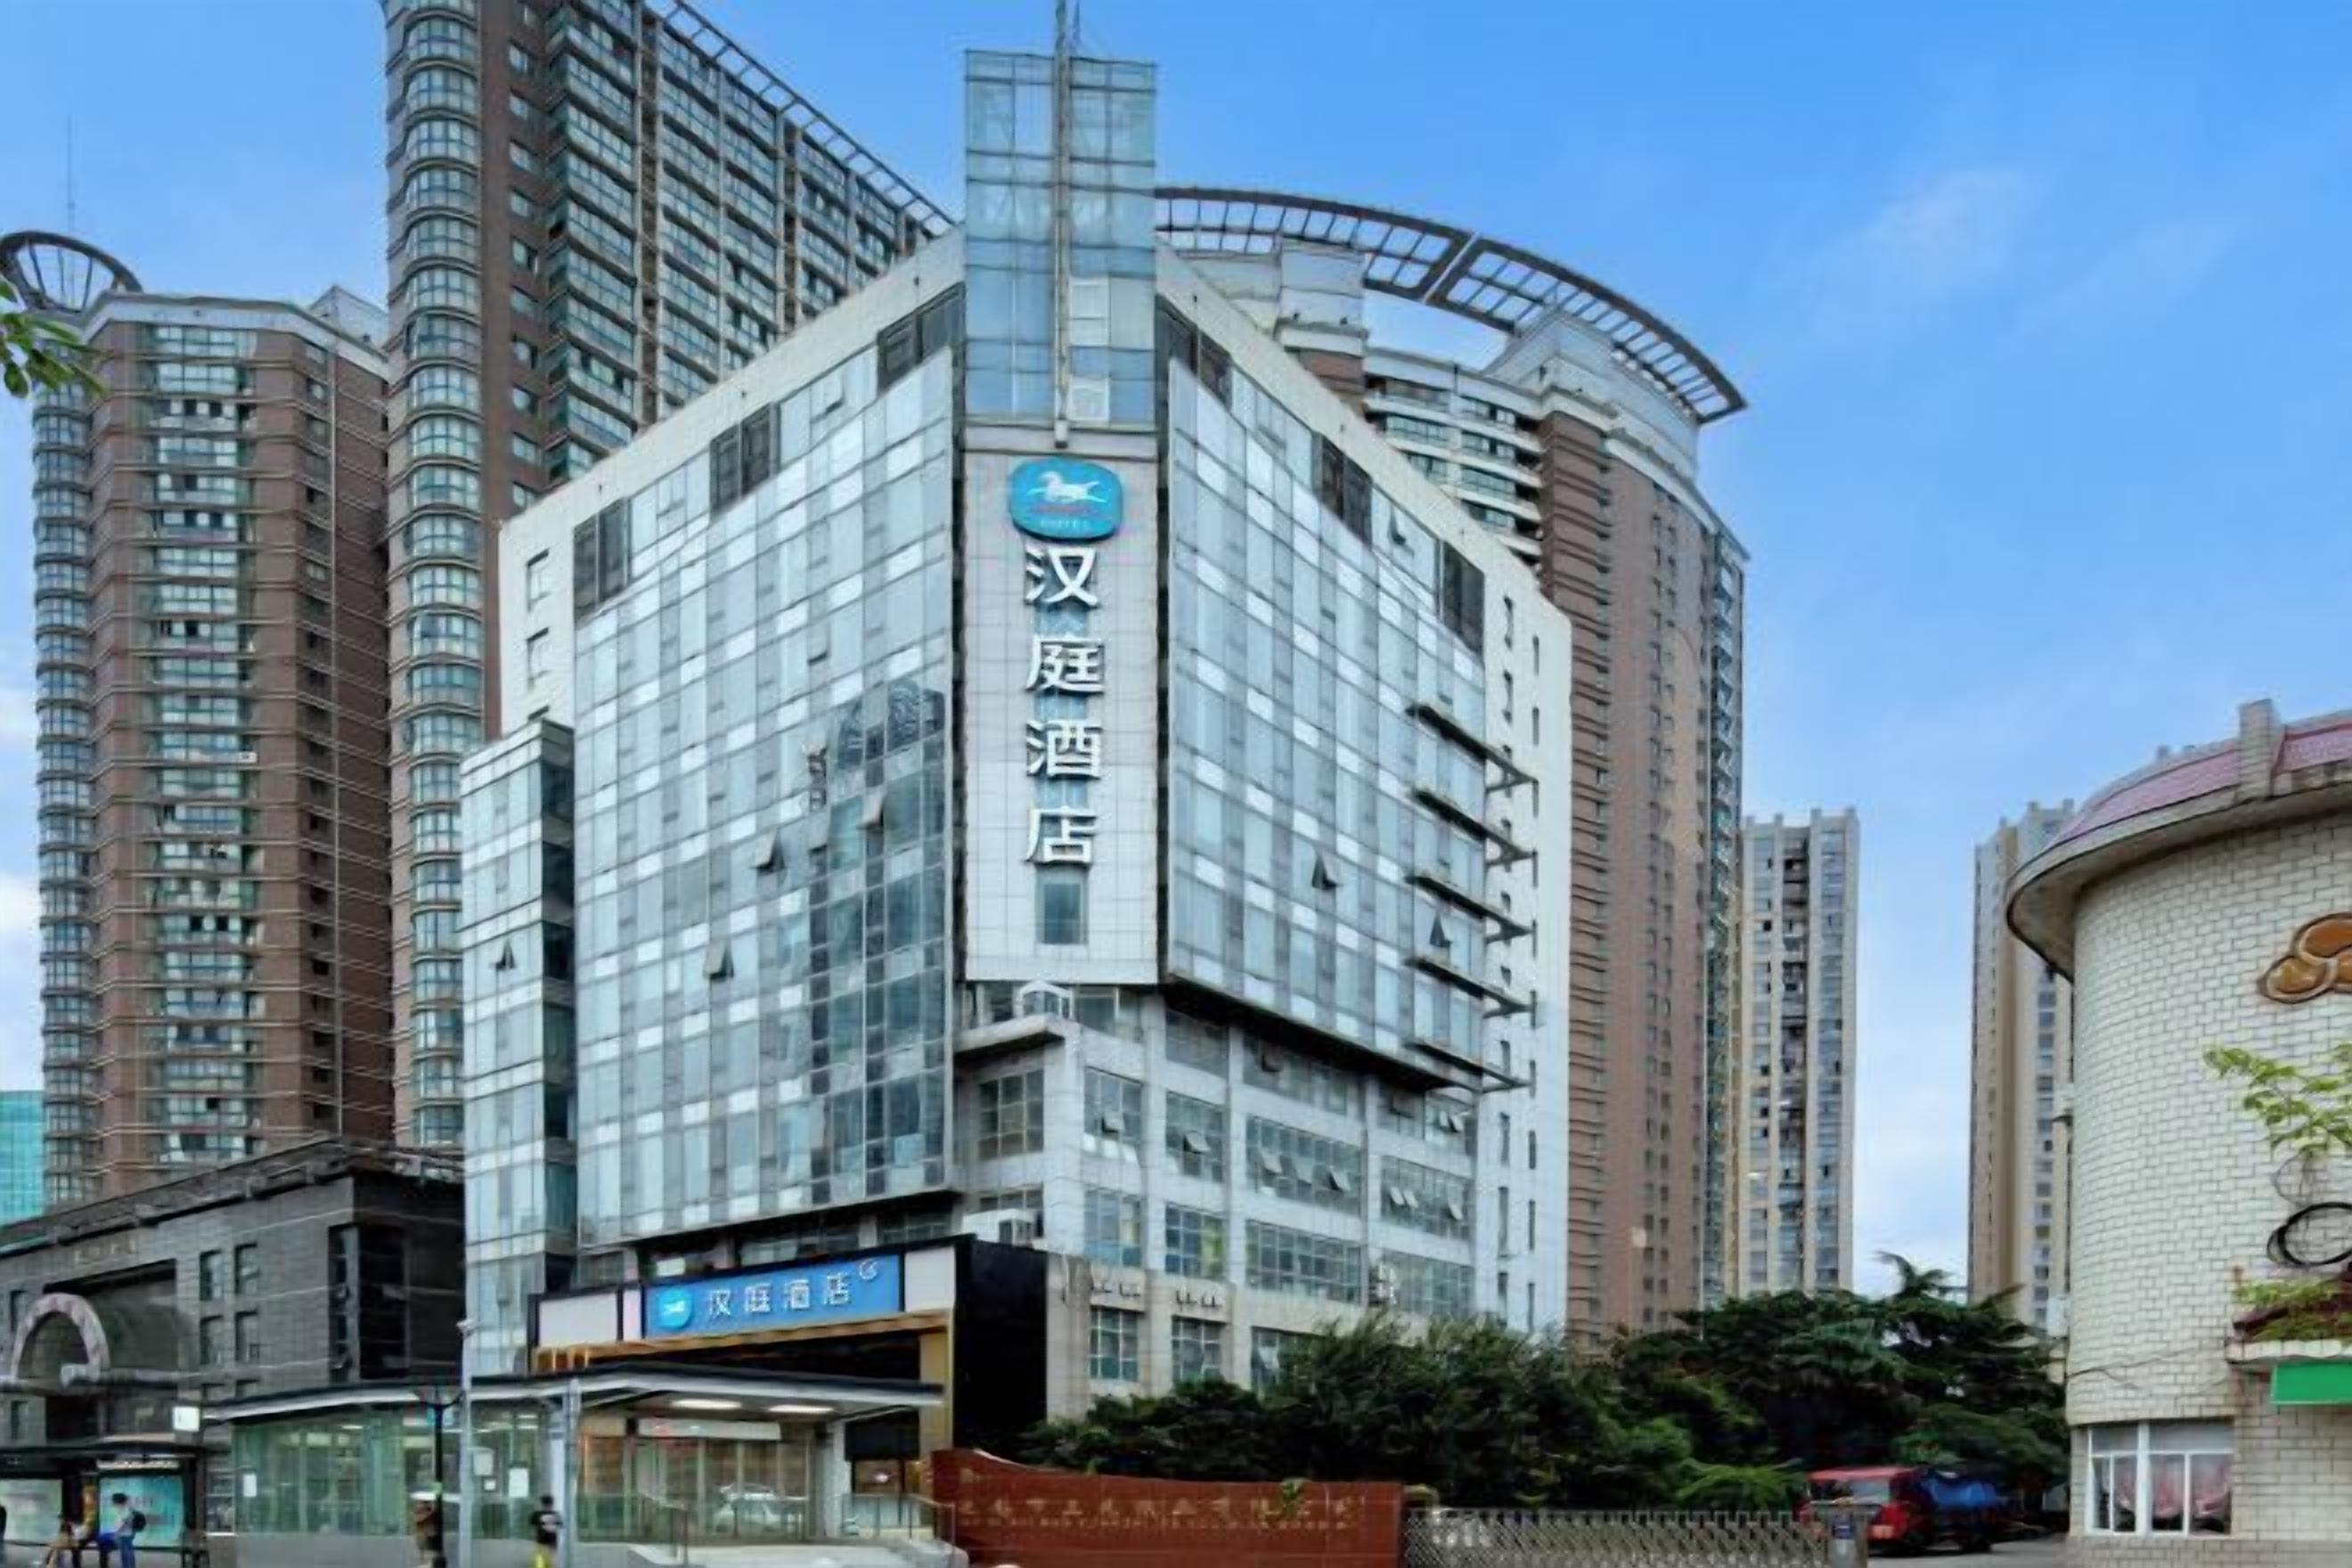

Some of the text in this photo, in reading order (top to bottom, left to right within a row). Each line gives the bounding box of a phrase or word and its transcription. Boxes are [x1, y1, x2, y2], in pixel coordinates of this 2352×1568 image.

[1025, 545, 1104, 862] 汉庭酒店
[707, 1272, 851, 1318] 汉庭酒店
